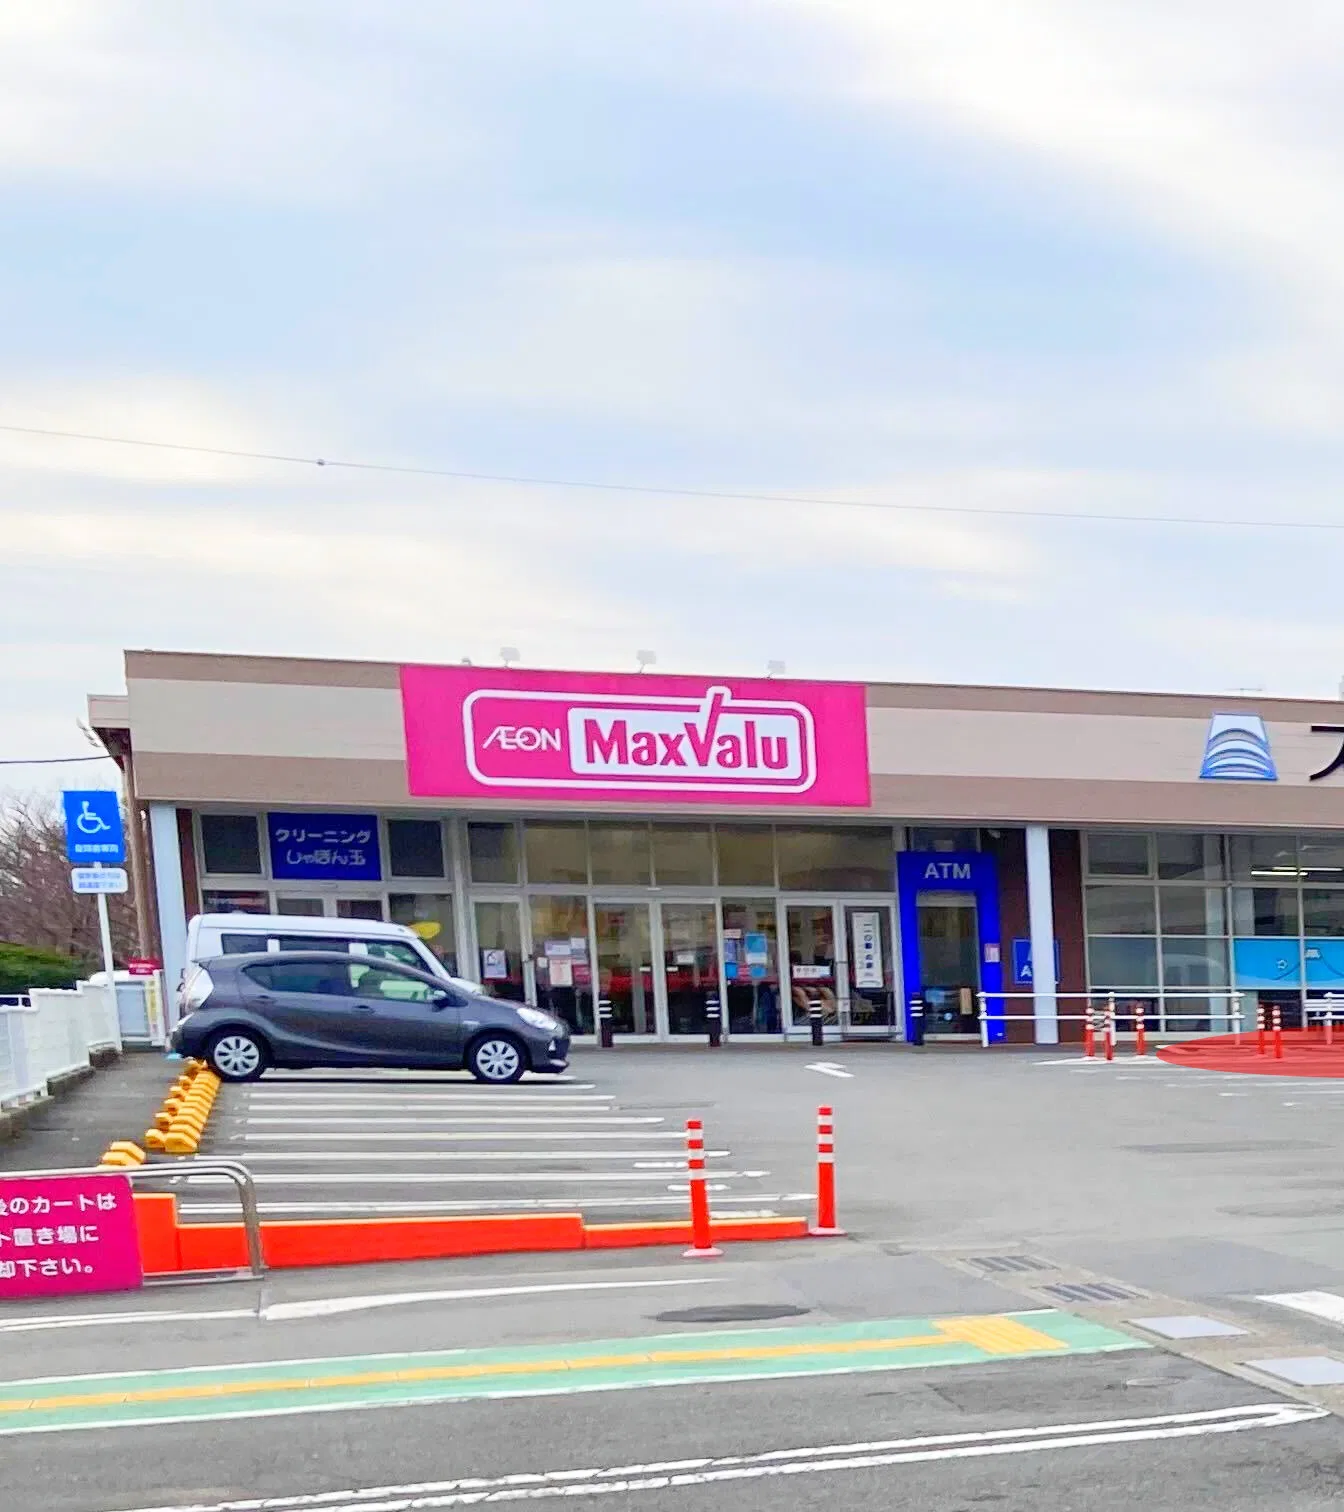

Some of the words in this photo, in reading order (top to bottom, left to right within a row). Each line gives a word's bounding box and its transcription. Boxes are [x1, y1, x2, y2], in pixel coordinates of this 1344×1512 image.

[583, 692, 789, 770] MaxValu
[275, 828, 371, 844] クリーニング
[286, 849, 366, 866] しゃぼん玉
[924, 862, 971, 879] ATM
